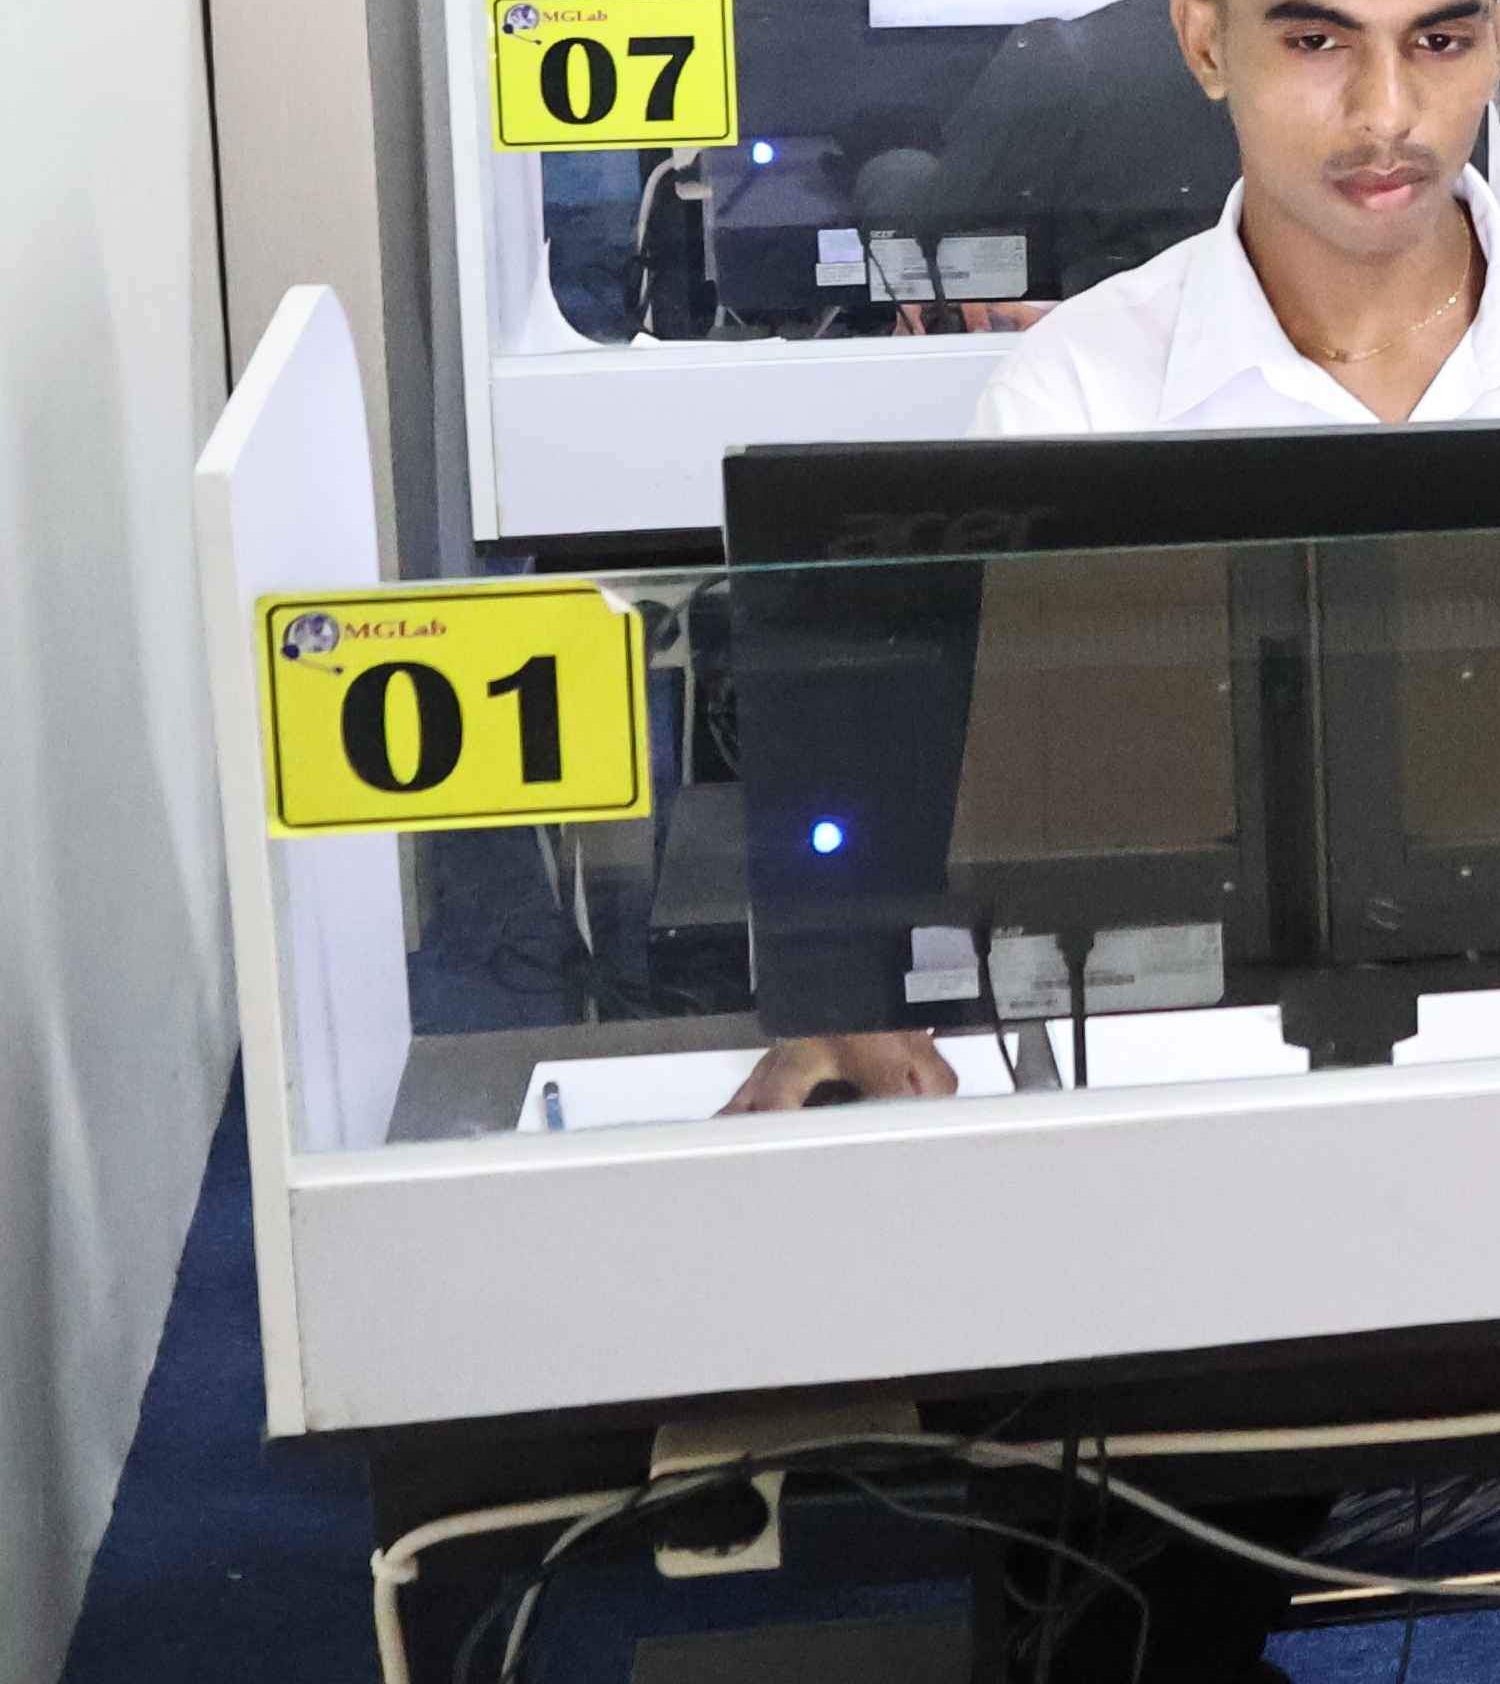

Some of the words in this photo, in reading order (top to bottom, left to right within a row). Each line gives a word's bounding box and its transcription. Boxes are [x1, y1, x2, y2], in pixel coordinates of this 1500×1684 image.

[541, 8, 608, 23] MGLab
[539, 34, 697, 126] 07
[344, 617, 447, 641] MGLab
[341, 655, 564, 794] 01
